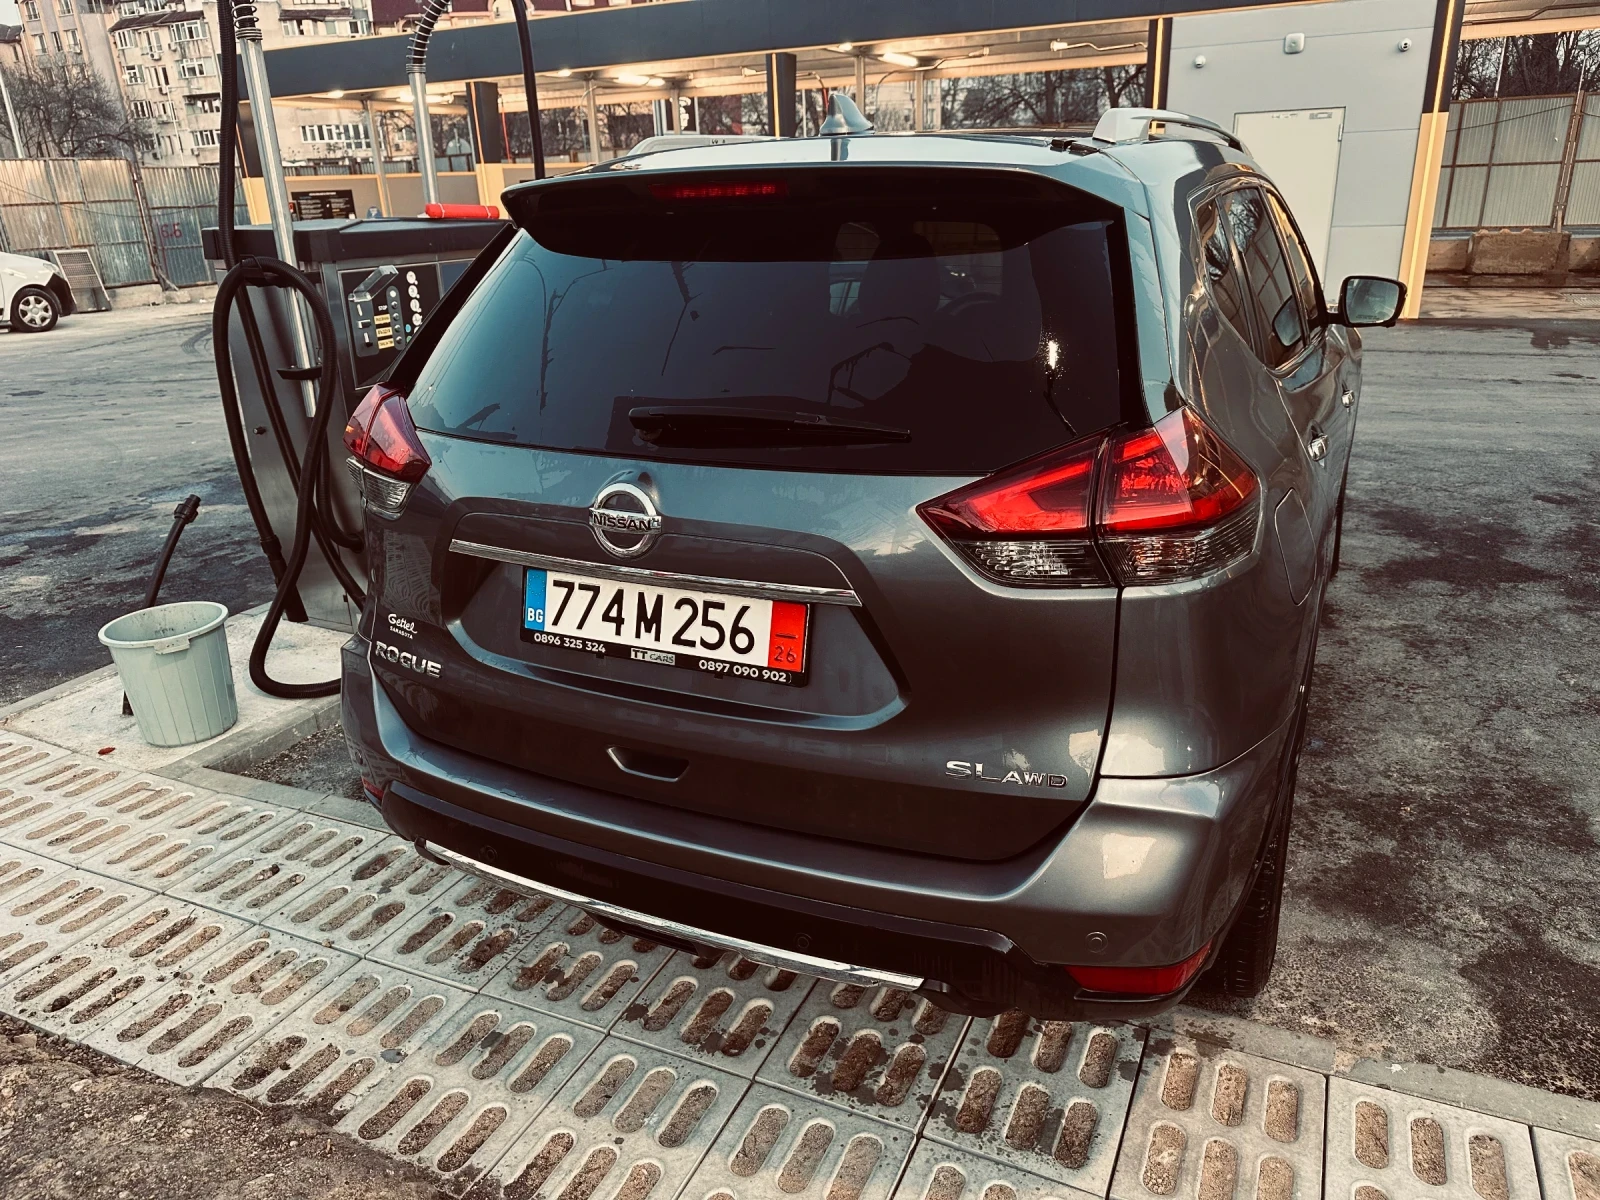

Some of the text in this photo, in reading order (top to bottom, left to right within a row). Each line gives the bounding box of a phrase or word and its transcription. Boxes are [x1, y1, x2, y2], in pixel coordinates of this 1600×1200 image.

[593, 513, 651, 531] NISSAN
[388, 613, 418, 634] Gettel
[527, 607, 544, 623] BG
[551, 579, 755, 655] 774 M 256
[389, 625, 414, 640] SARASOTA
[533, 632, 606, 653] 0896 325 324
[375, 640, 442, 679] ROGUE
[632, 649, 675, 664] TT CARS
[773, 644, 797, 664] 26
[698, 659, 787, 683] 0897 090 902
